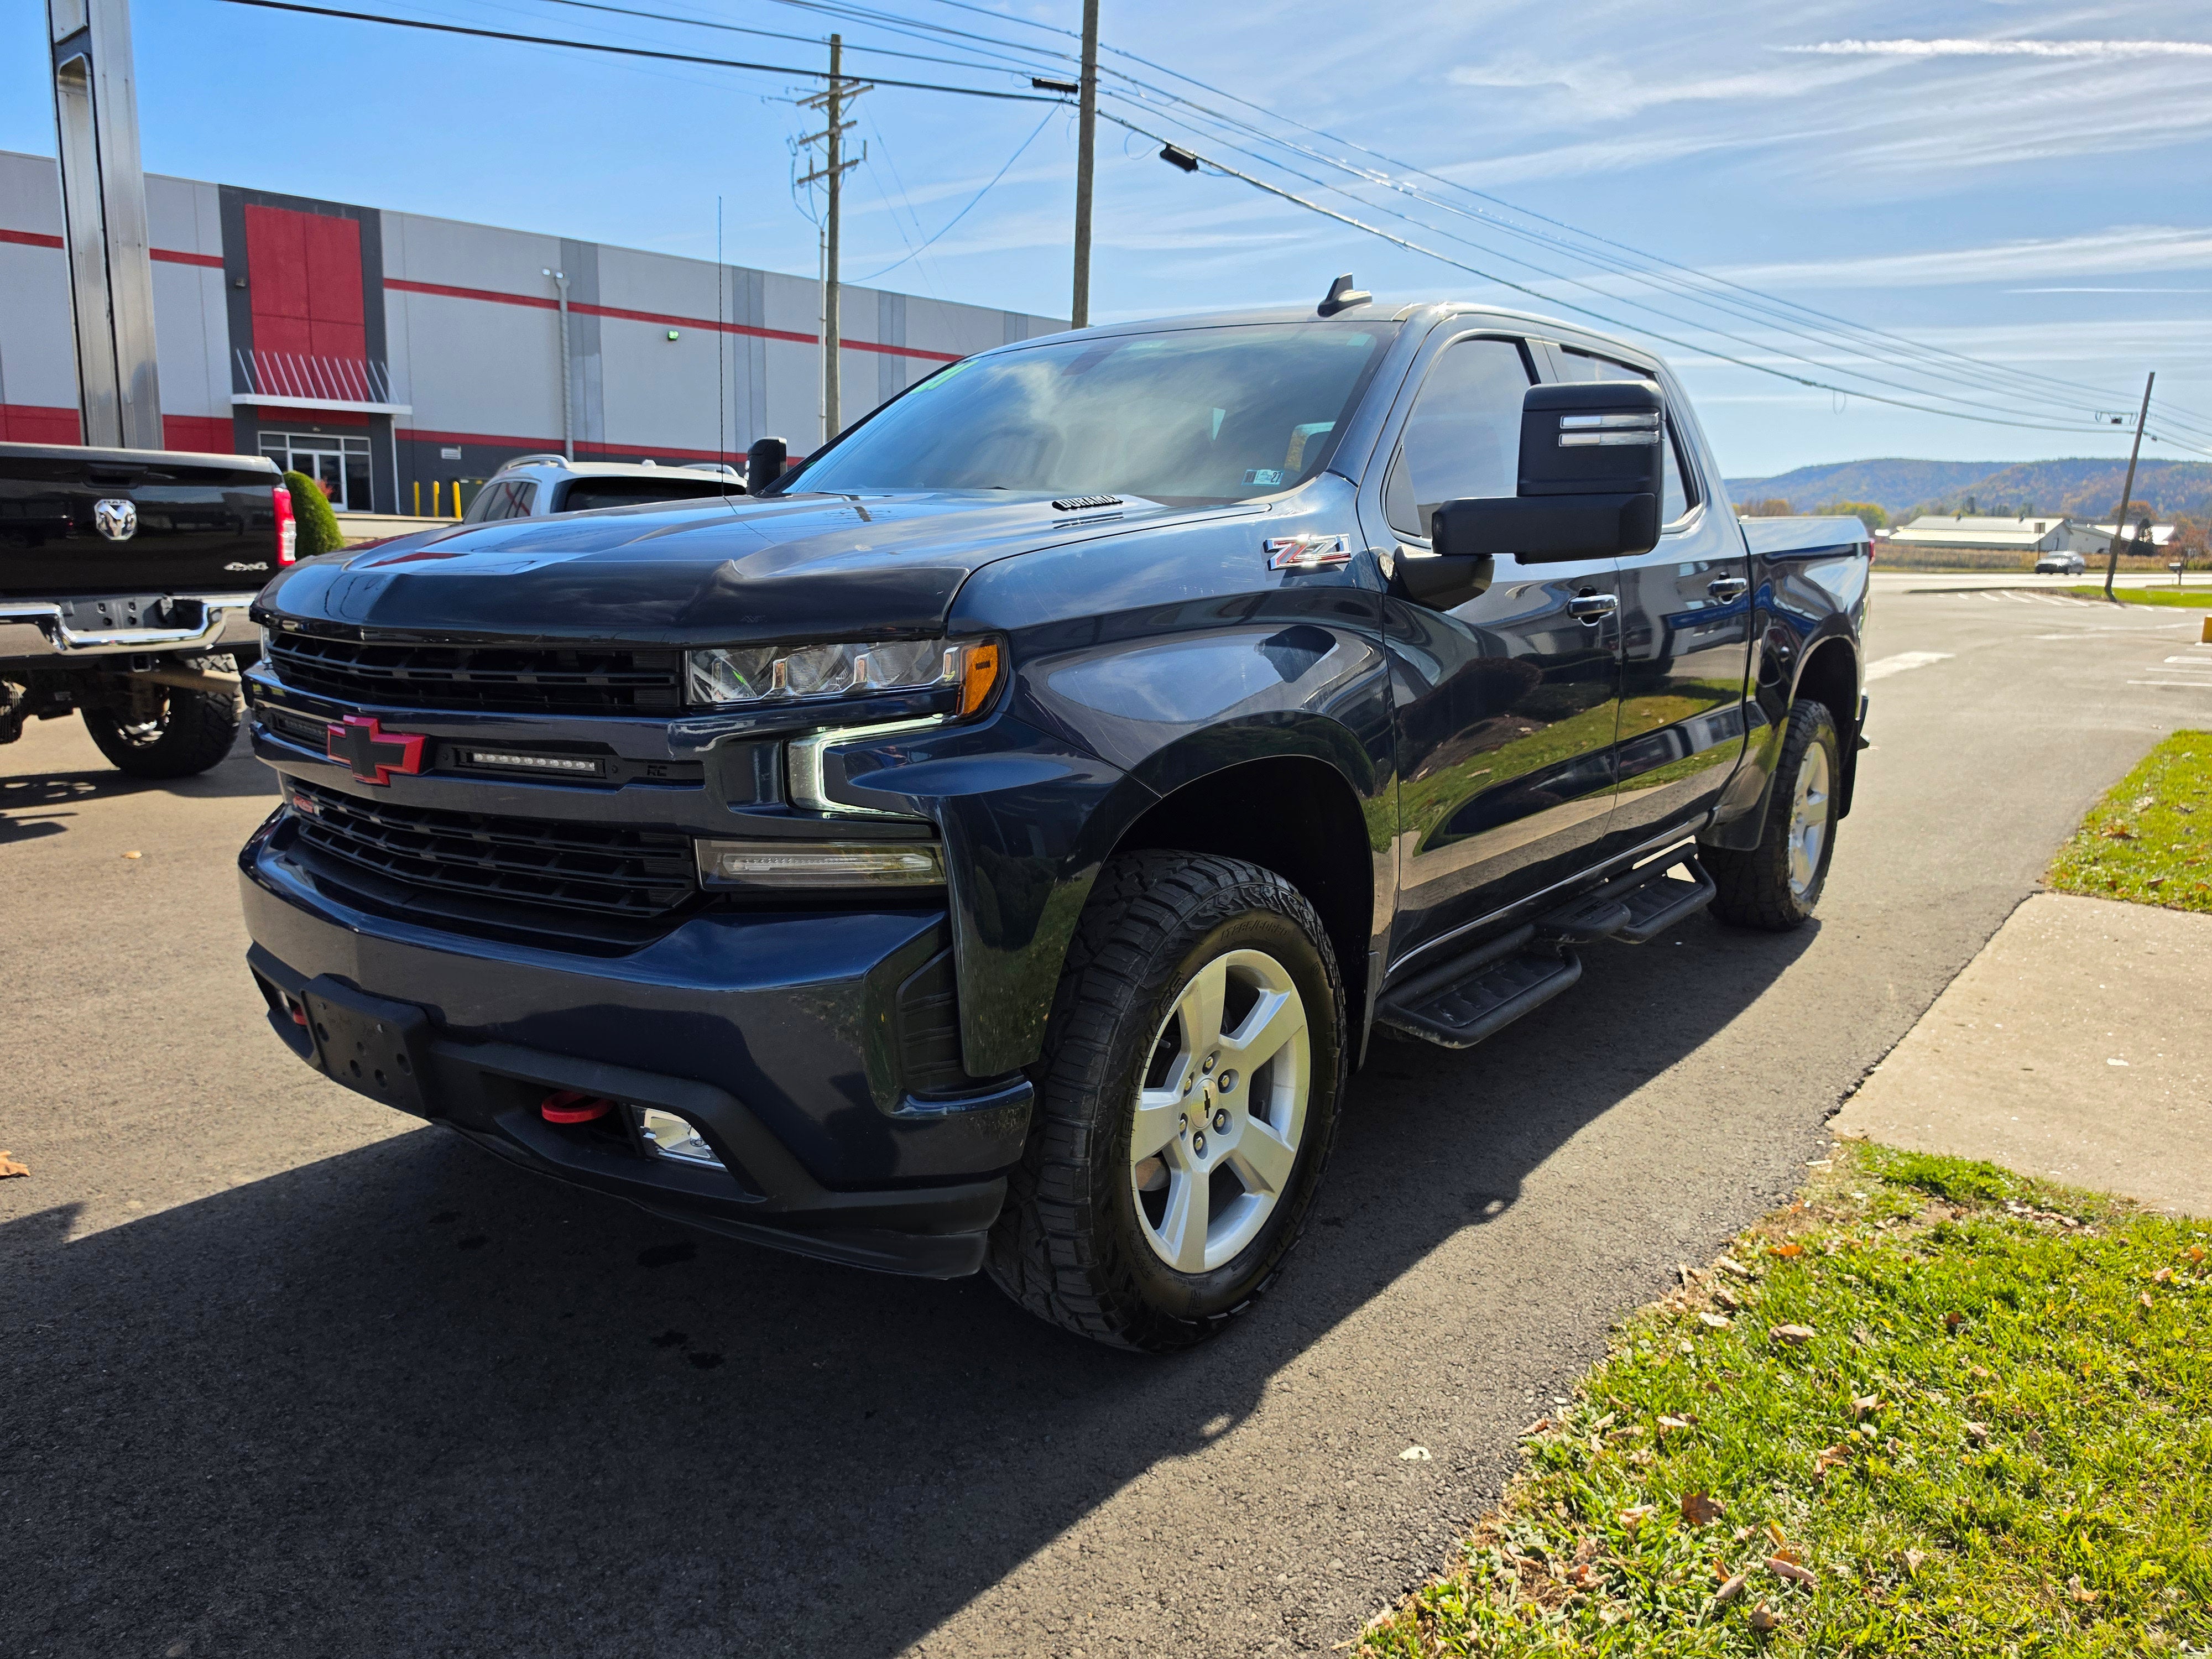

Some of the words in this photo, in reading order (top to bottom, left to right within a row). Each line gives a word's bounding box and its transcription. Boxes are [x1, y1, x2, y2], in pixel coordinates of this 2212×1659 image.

[1270, 472, 1282, 484] 27
[1053, 494, 1123, 510] DURAMAX
[1263, 534, 1353, 571] Z71
